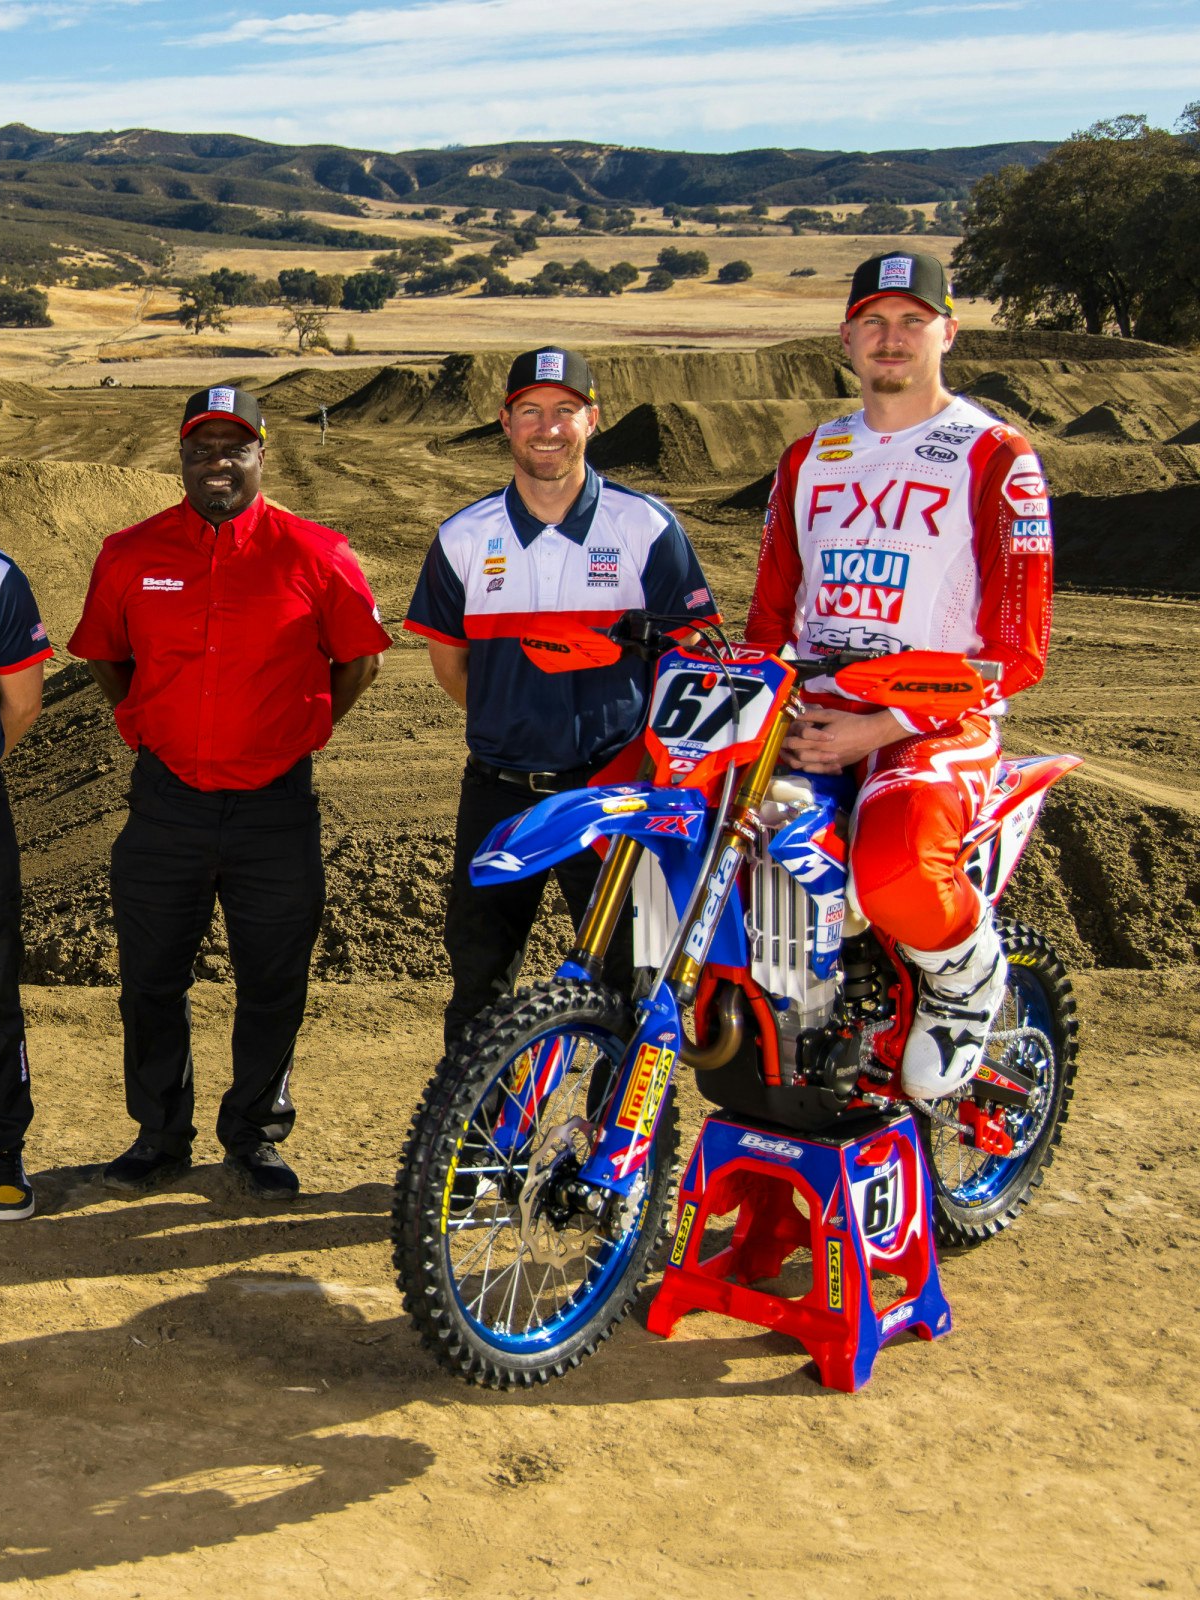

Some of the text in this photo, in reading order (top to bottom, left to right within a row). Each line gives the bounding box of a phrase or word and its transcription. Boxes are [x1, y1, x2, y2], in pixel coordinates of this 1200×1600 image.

[880, 436, 892, 444] 67
[925, 431, 971, 445] pod
[808, 479, 950, 537] FXR
[1023, 503, 1045, 513] FXR
[1014, 521, 1050, 537] LIQU
[1013, 537, 1050, 552] MOLY
[592, 554, 617, 563] LIQUI
[592, 562, 617, 571] MOLY
[824, 552, 904, 586] LIQUI
[143, 578, 184, 586] Beta
[819, 585, 903, 620] MOLY
[522, 637, 571, 654] ACERBIS
[806, 621, 903, 655] Beta
[686, 662, 742, 673] SUPERCROSS
[889, 682, 974, 693] ACERBIS
[651, 672, 766, 743] 67
[683, 845, 739, 964] Beta
[826, 910, 843, 923] MOLY
[617, 1043, 660, 1130] PIRELLI
[643, 1052, 673, 1134] ACERBIS
[738, 1132, 804, 1159] Beta
[671, 1204, 696, 1264] ACERBIS
[828, 1243, 842, 1307] ACERBIS
[881, 1305, 914, 1335] Beta
